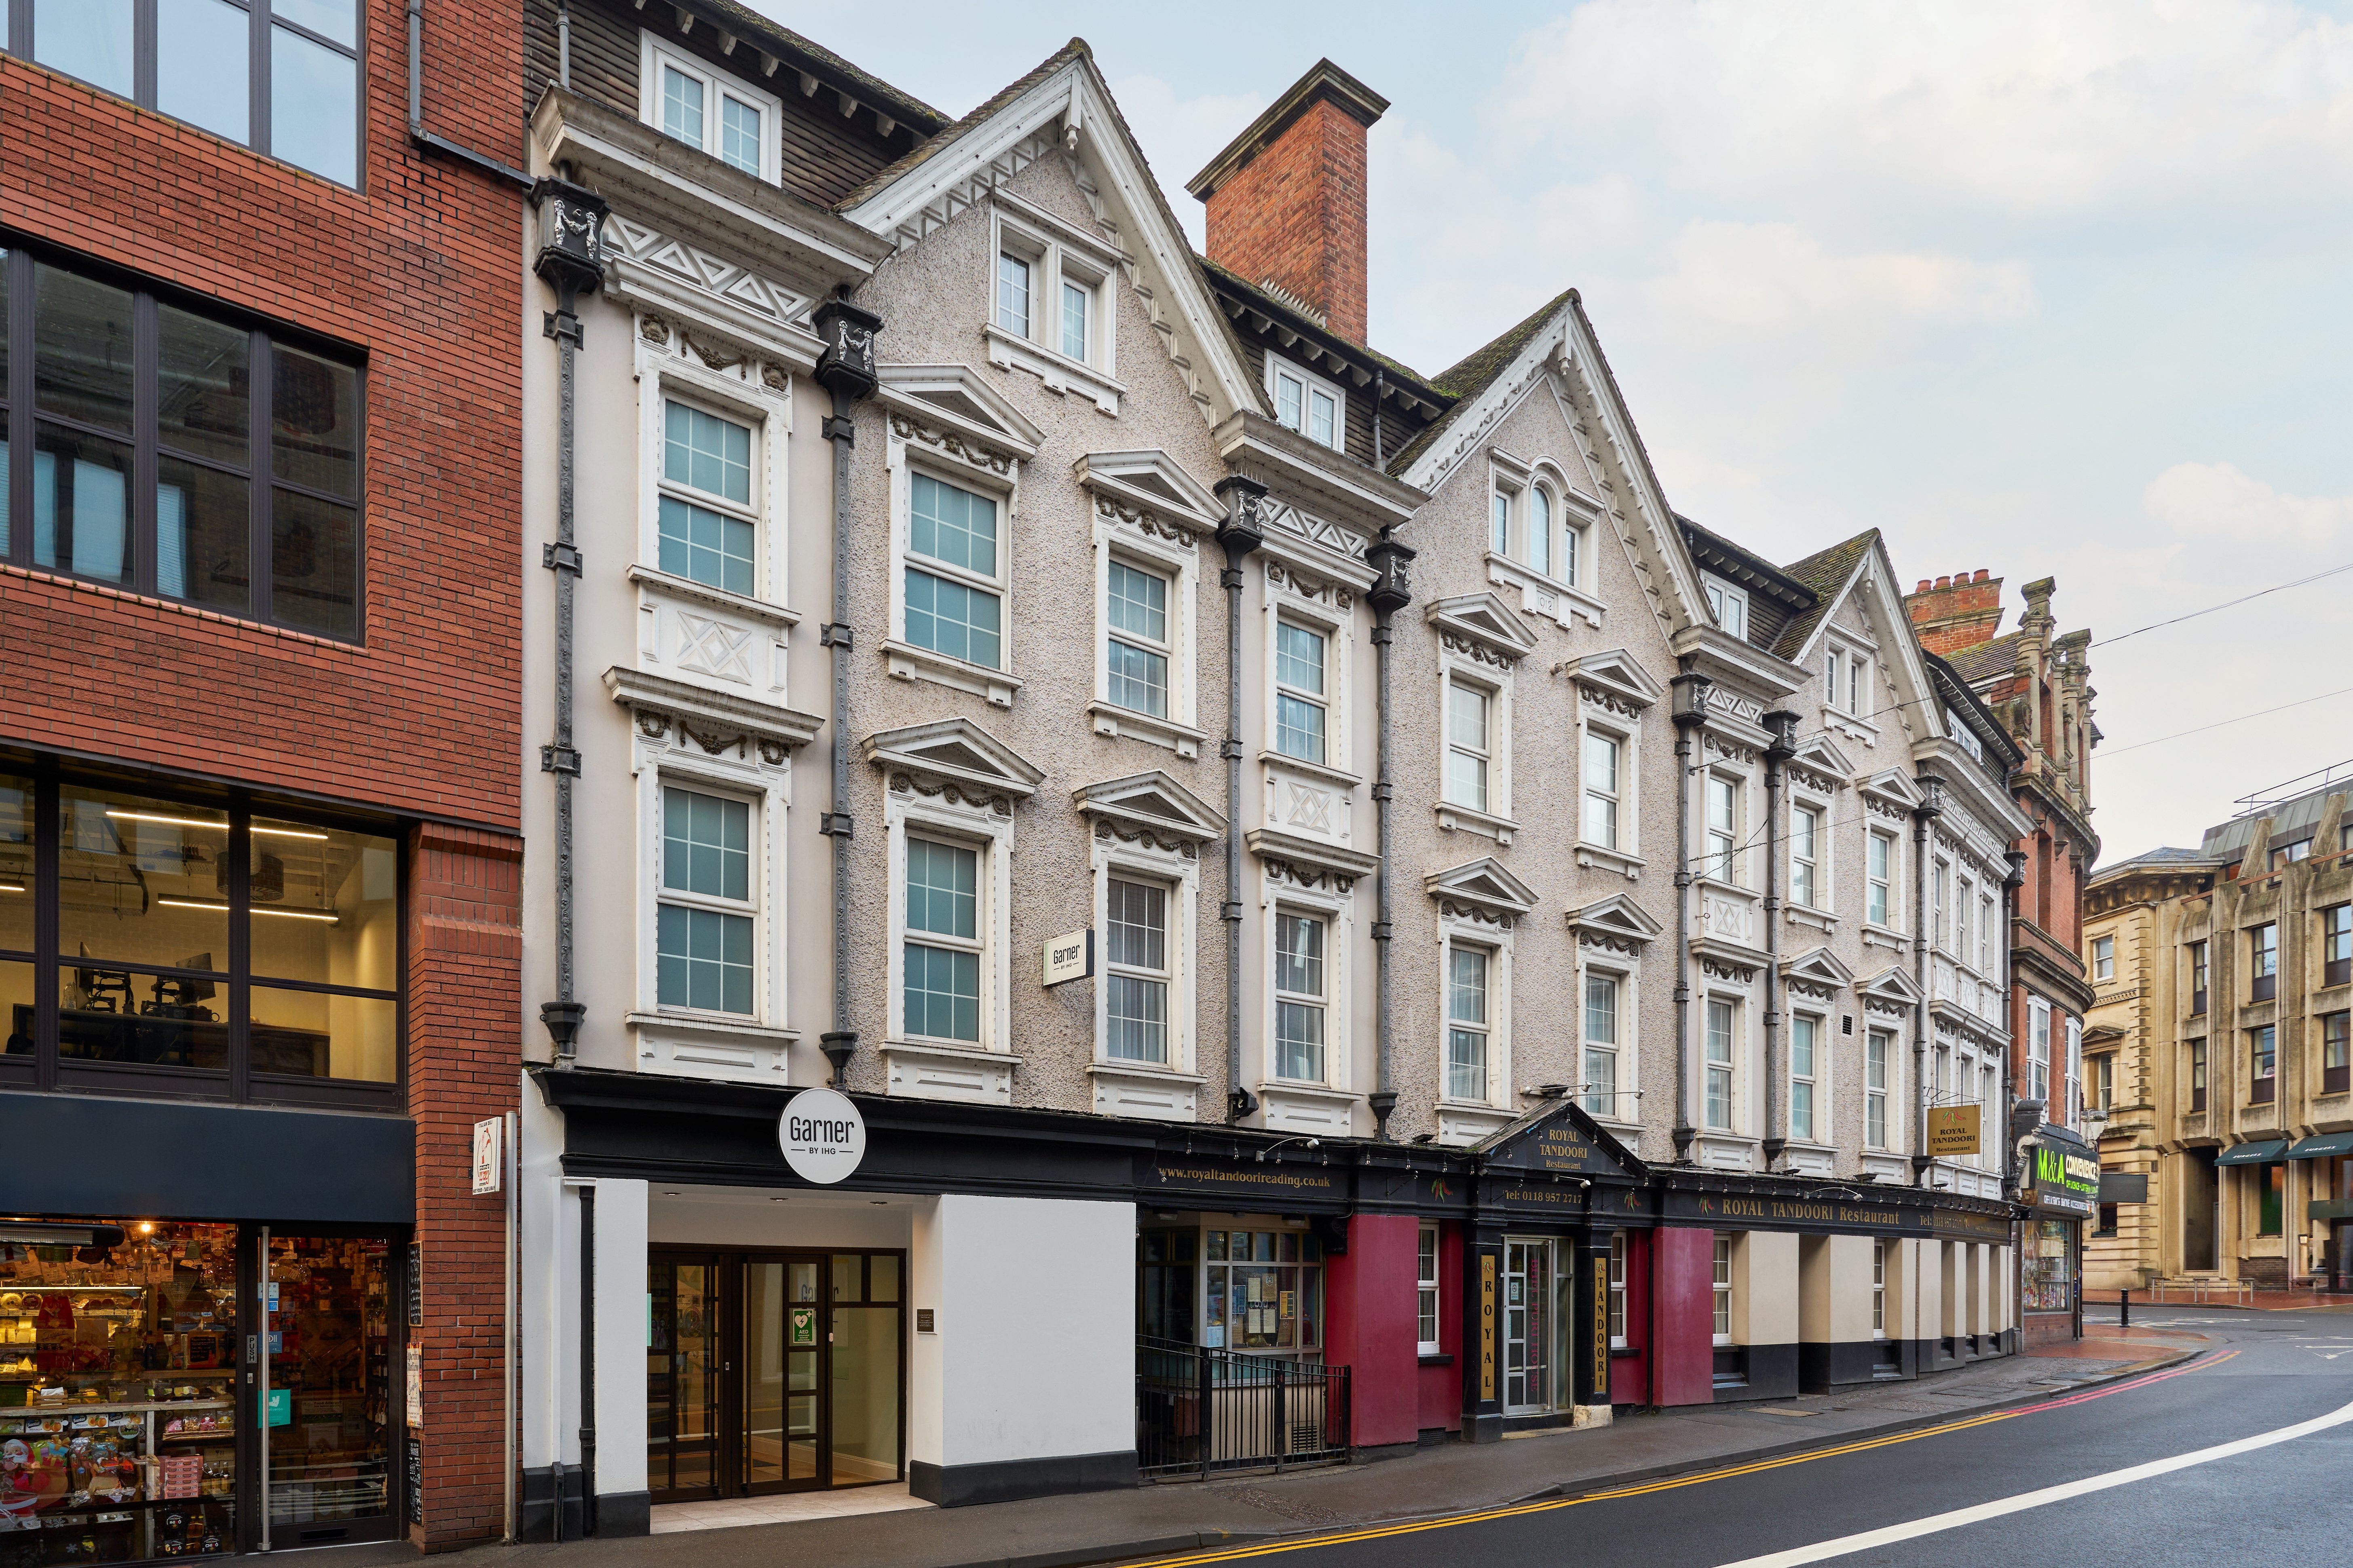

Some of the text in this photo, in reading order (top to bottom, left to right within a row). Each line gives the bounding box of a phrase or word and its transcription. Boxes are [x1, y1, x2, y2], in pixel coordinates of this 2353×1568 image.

[1054, 945, 1080, 964] Garner
[790, 1116, 854, 1143] Garner
[1549, 1129, 1579, 1142] ROYAL
[1932, 1135, 1976, 1144] TANDOORI
[1539, 1144, 1588, 1159] TANDOORI
[1545, 1159, 1581, 1170] Restaurant
[2037, 1148, 2065, 1184] M&A
[2066, 1154, 2096, 1180] CONVENIENCE
[1158, 1167, 1331, 1188] www.royaltandoorireading.co.uk
[1505, 1190, 1582, 1204] Tel: 0118 957 2717
[1722, 1199, 1899, 1225] ROYAL TANDOORI Restaurant
[1920, 1215, 1932, 1226] Tel:
[1933, 1216, 1943, 1227] 0118
[1952, 1218, 1961, 1229] 2717
